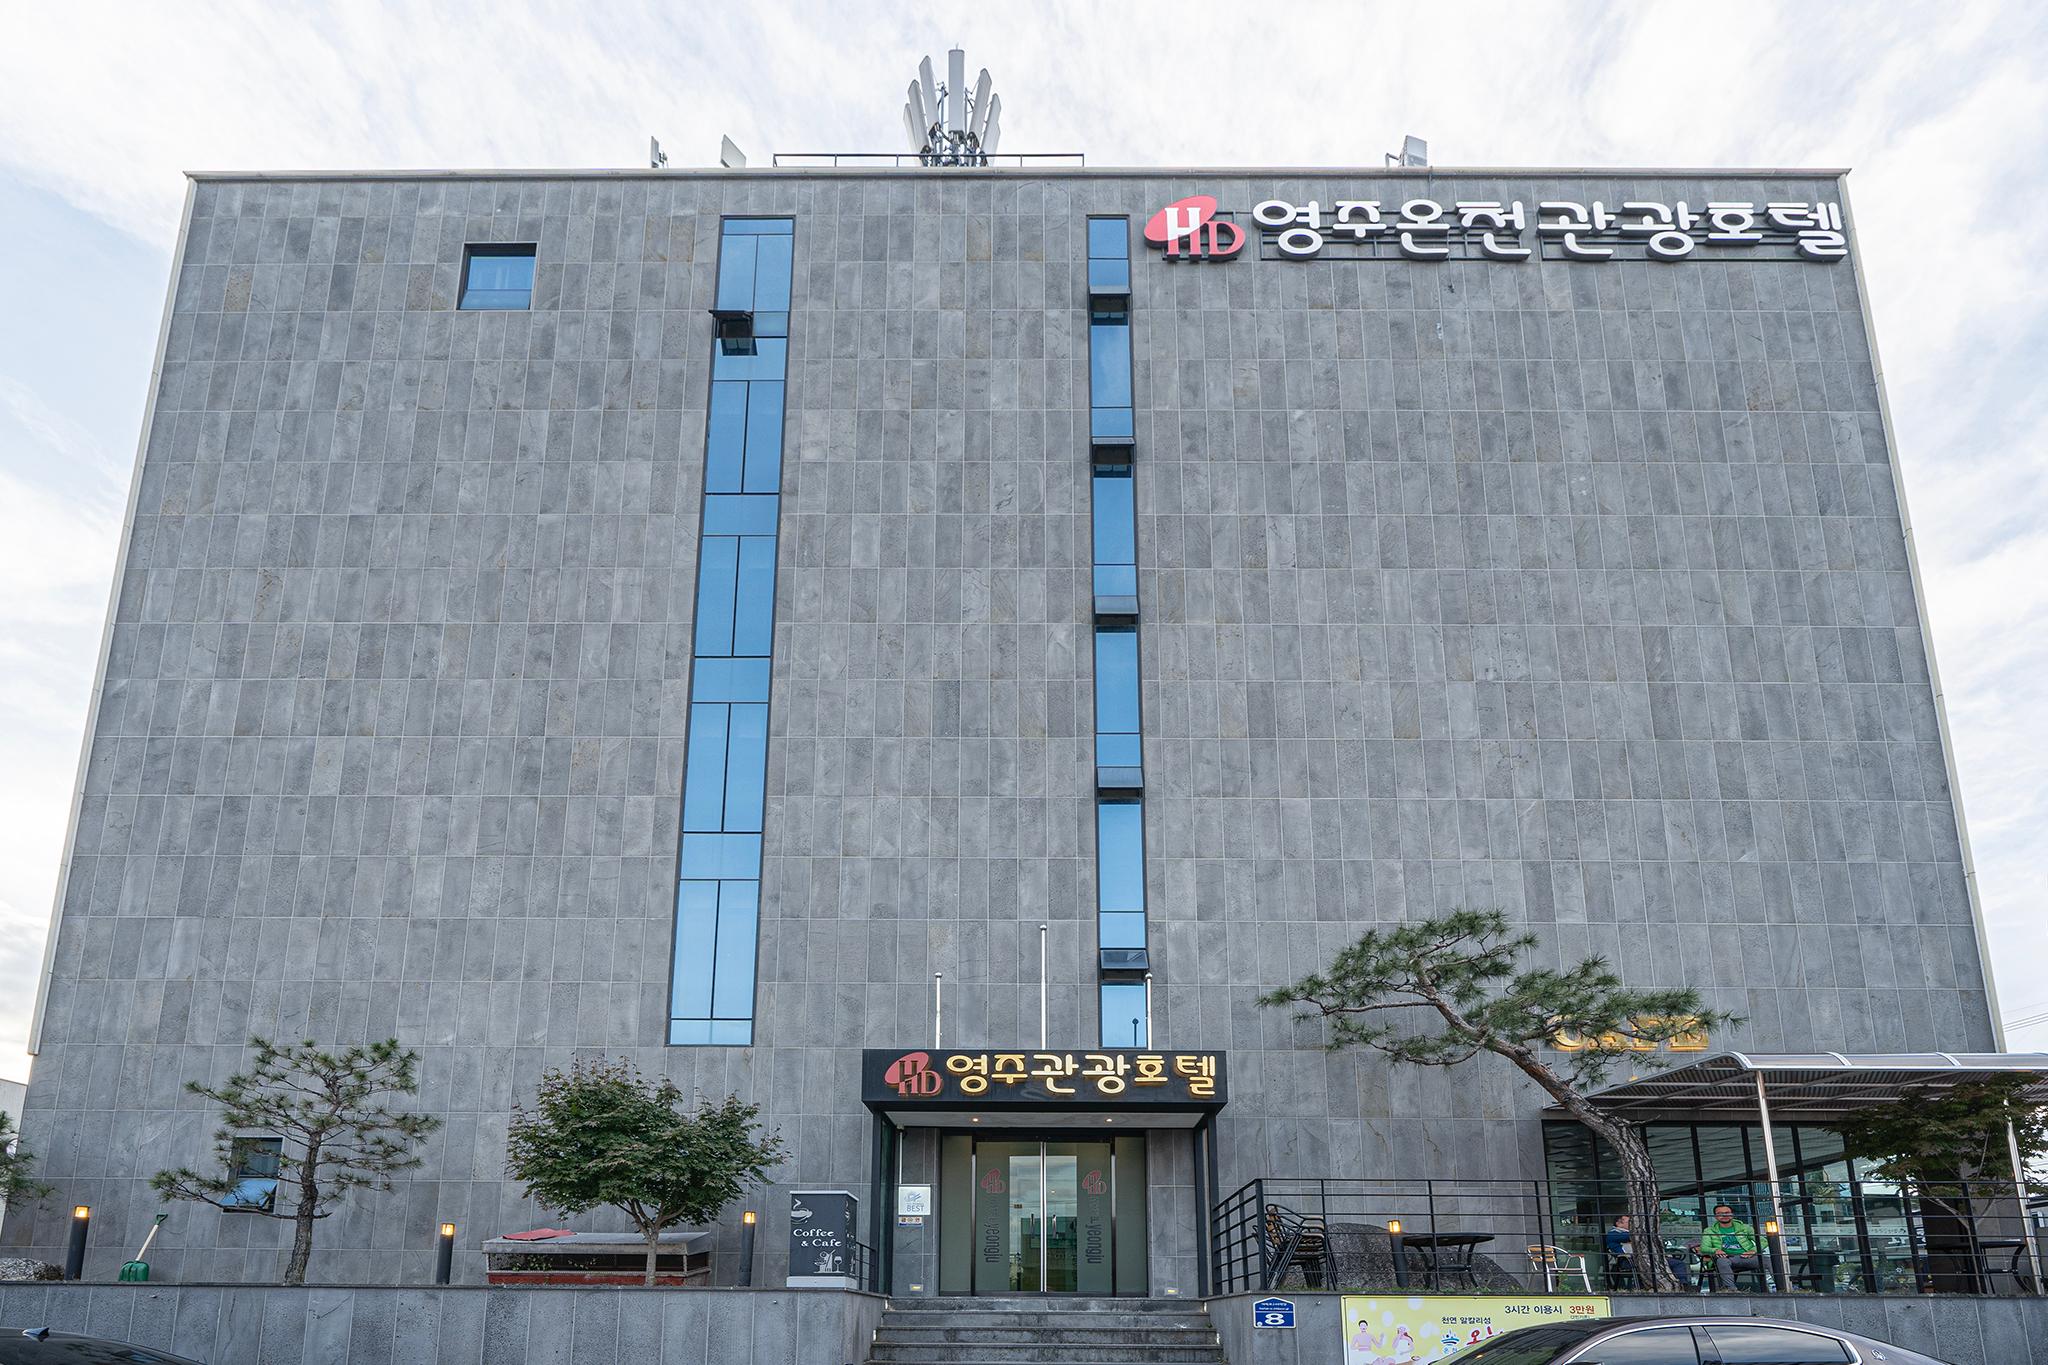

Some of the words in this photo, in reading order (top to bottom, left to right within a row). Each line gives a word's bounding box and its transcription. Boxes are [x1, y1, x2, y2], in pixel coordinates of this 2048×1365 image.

[1253, 199, 1848, 261] 영주온천관광호텔
[946, 1053, 1216, 1096] 영주관광호텔
[906, 1204, 925, 1213] BEST
[793, 1228, 835, 1237] Coffee
[812, 1238, 842, 1247] Cafe
[984, 1223, 1003, 1263] yeongju
[1085, 1224, 1104, 1264] yeongju
[1504, 1305, 1531, 1315] 3시간
[1533, 1305, 1563, 1315] 이용시
[1569, 1305, 1595, 1315] 3만원
[1264, 1312, 1286, 1325] 8
[1441, 1316, 1457, 1325] 천연
[1459, 1316, 1491, 1325] 알칼리성
